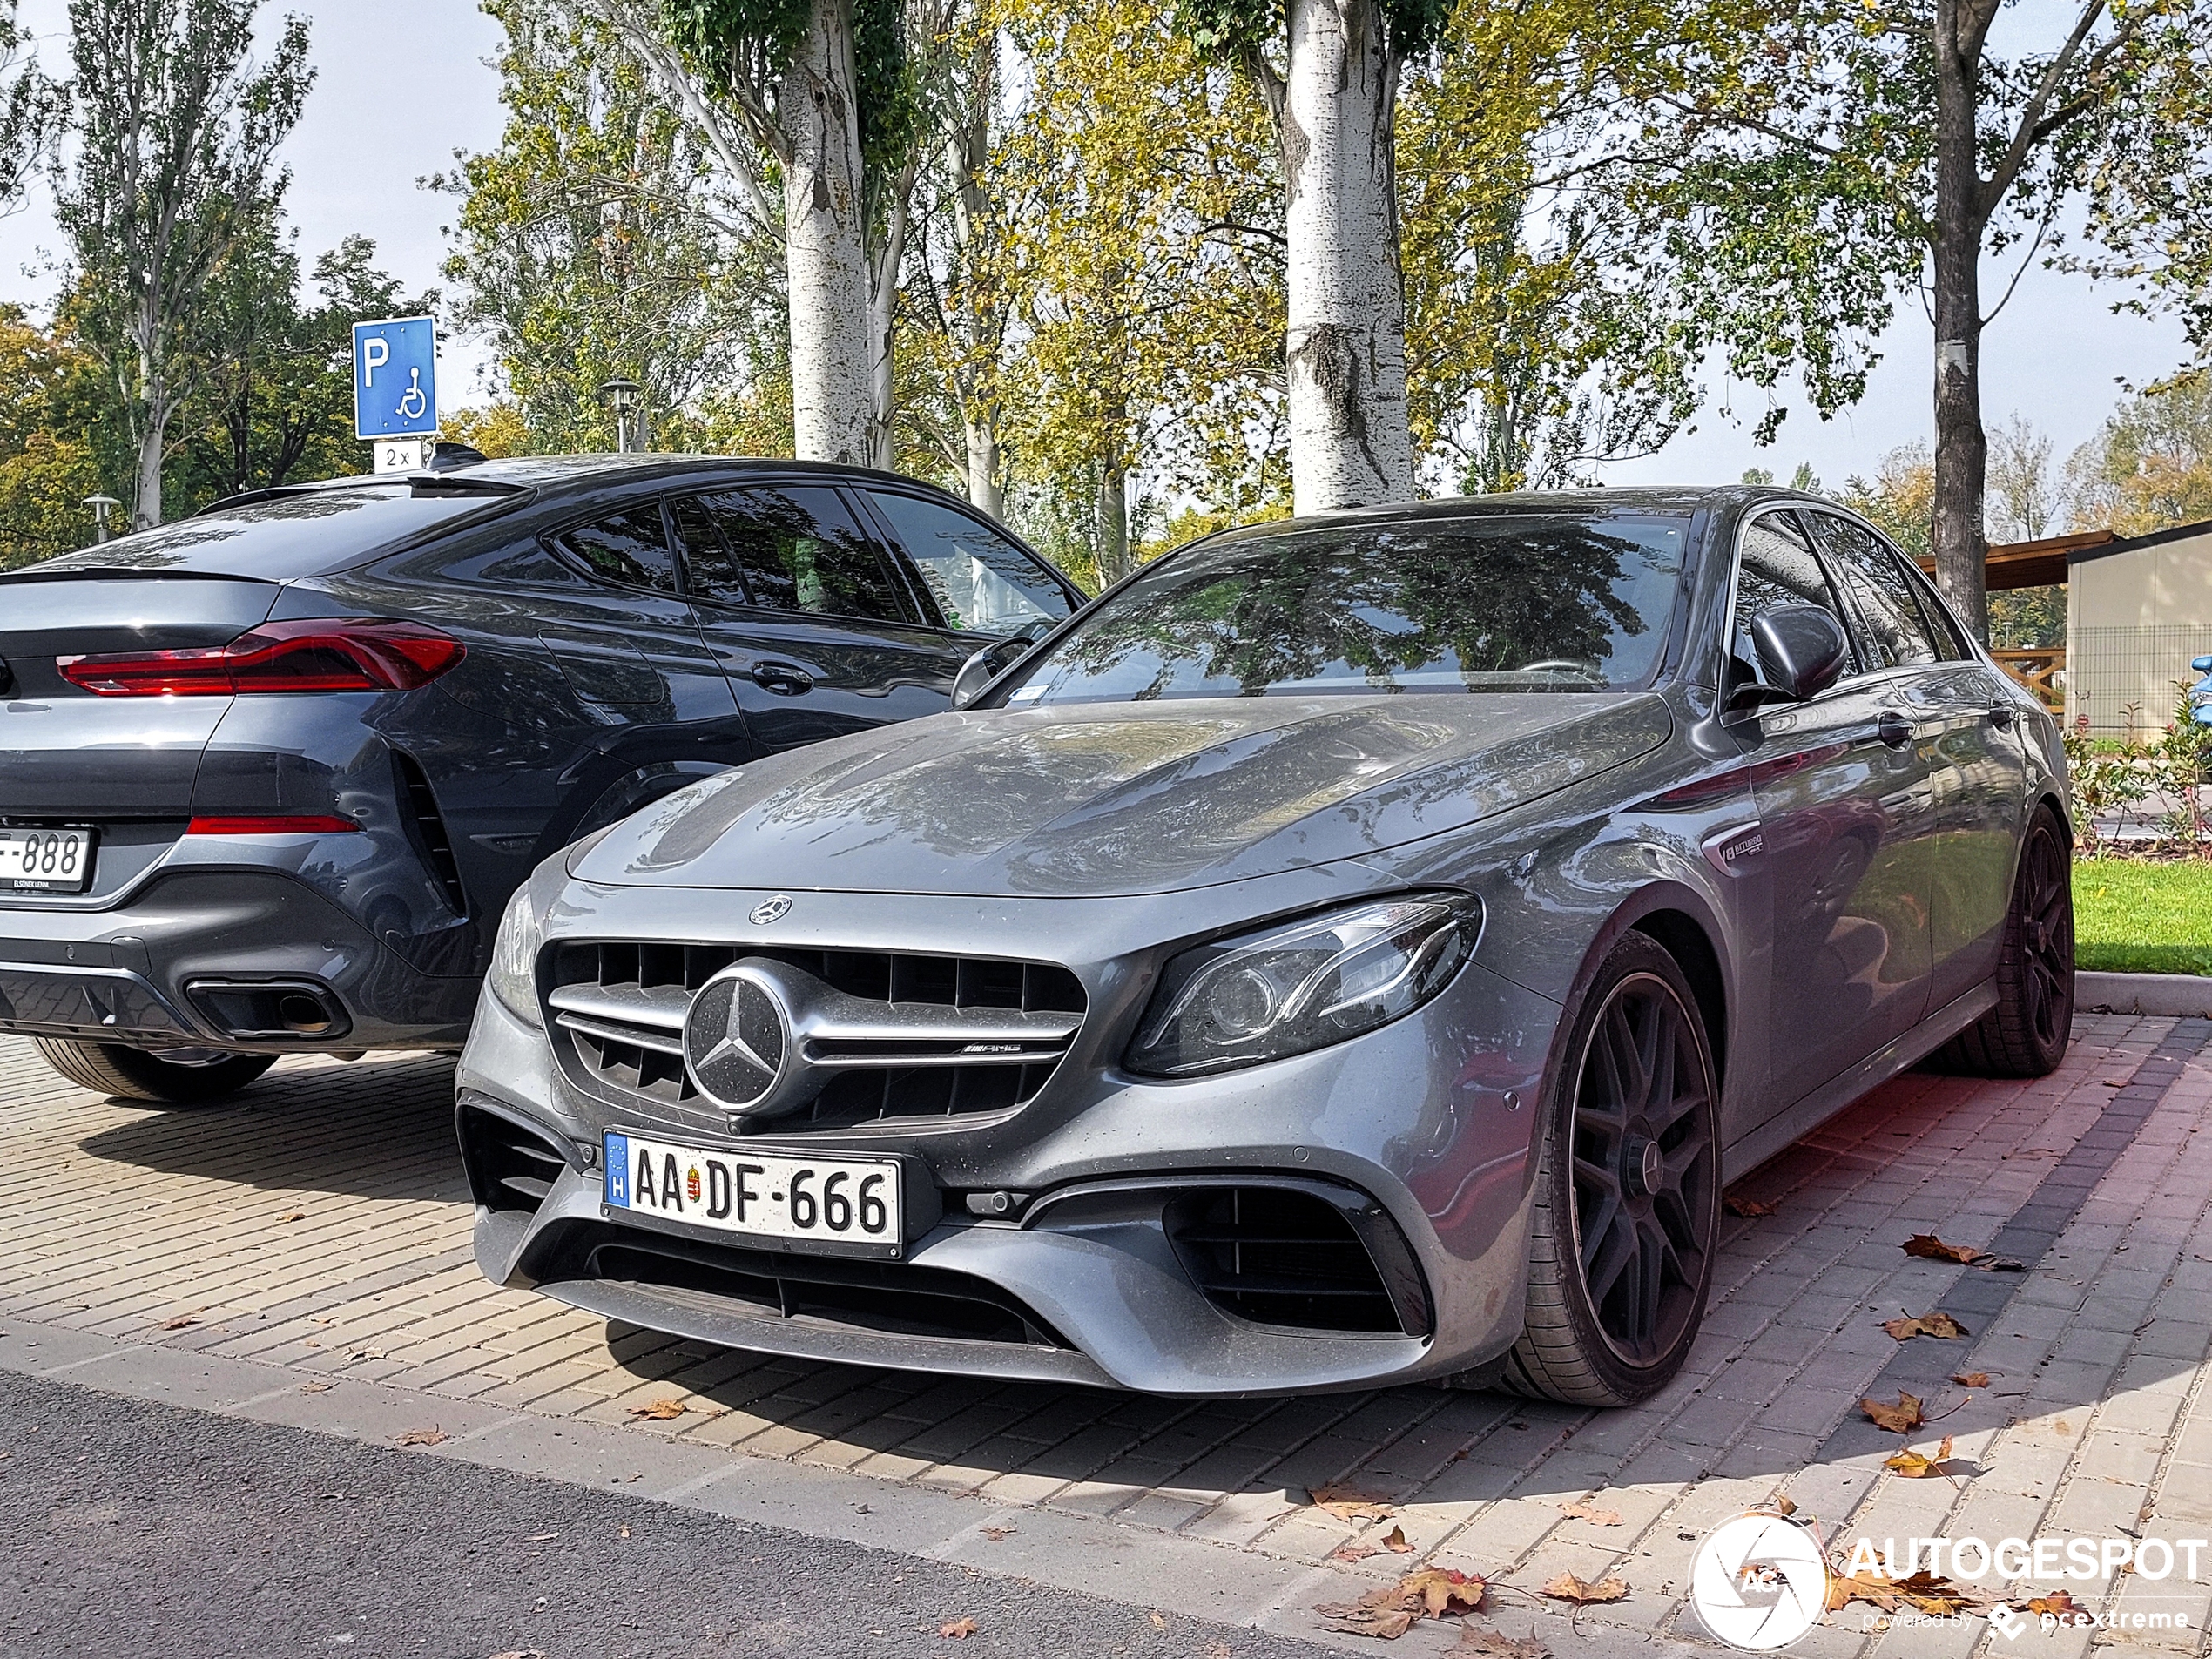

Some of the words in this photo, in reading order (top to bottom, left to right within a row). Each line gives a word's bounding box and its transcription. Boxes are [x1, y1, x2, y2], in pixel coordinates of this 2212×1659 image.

[364, 338, 389, 387] P
[386, 448, 396, 466] 2
[611, 1175, 625, 1200] H
[636, 1148, 685, 1213] AA
[706, 1159, 885, 1234] DF-666
